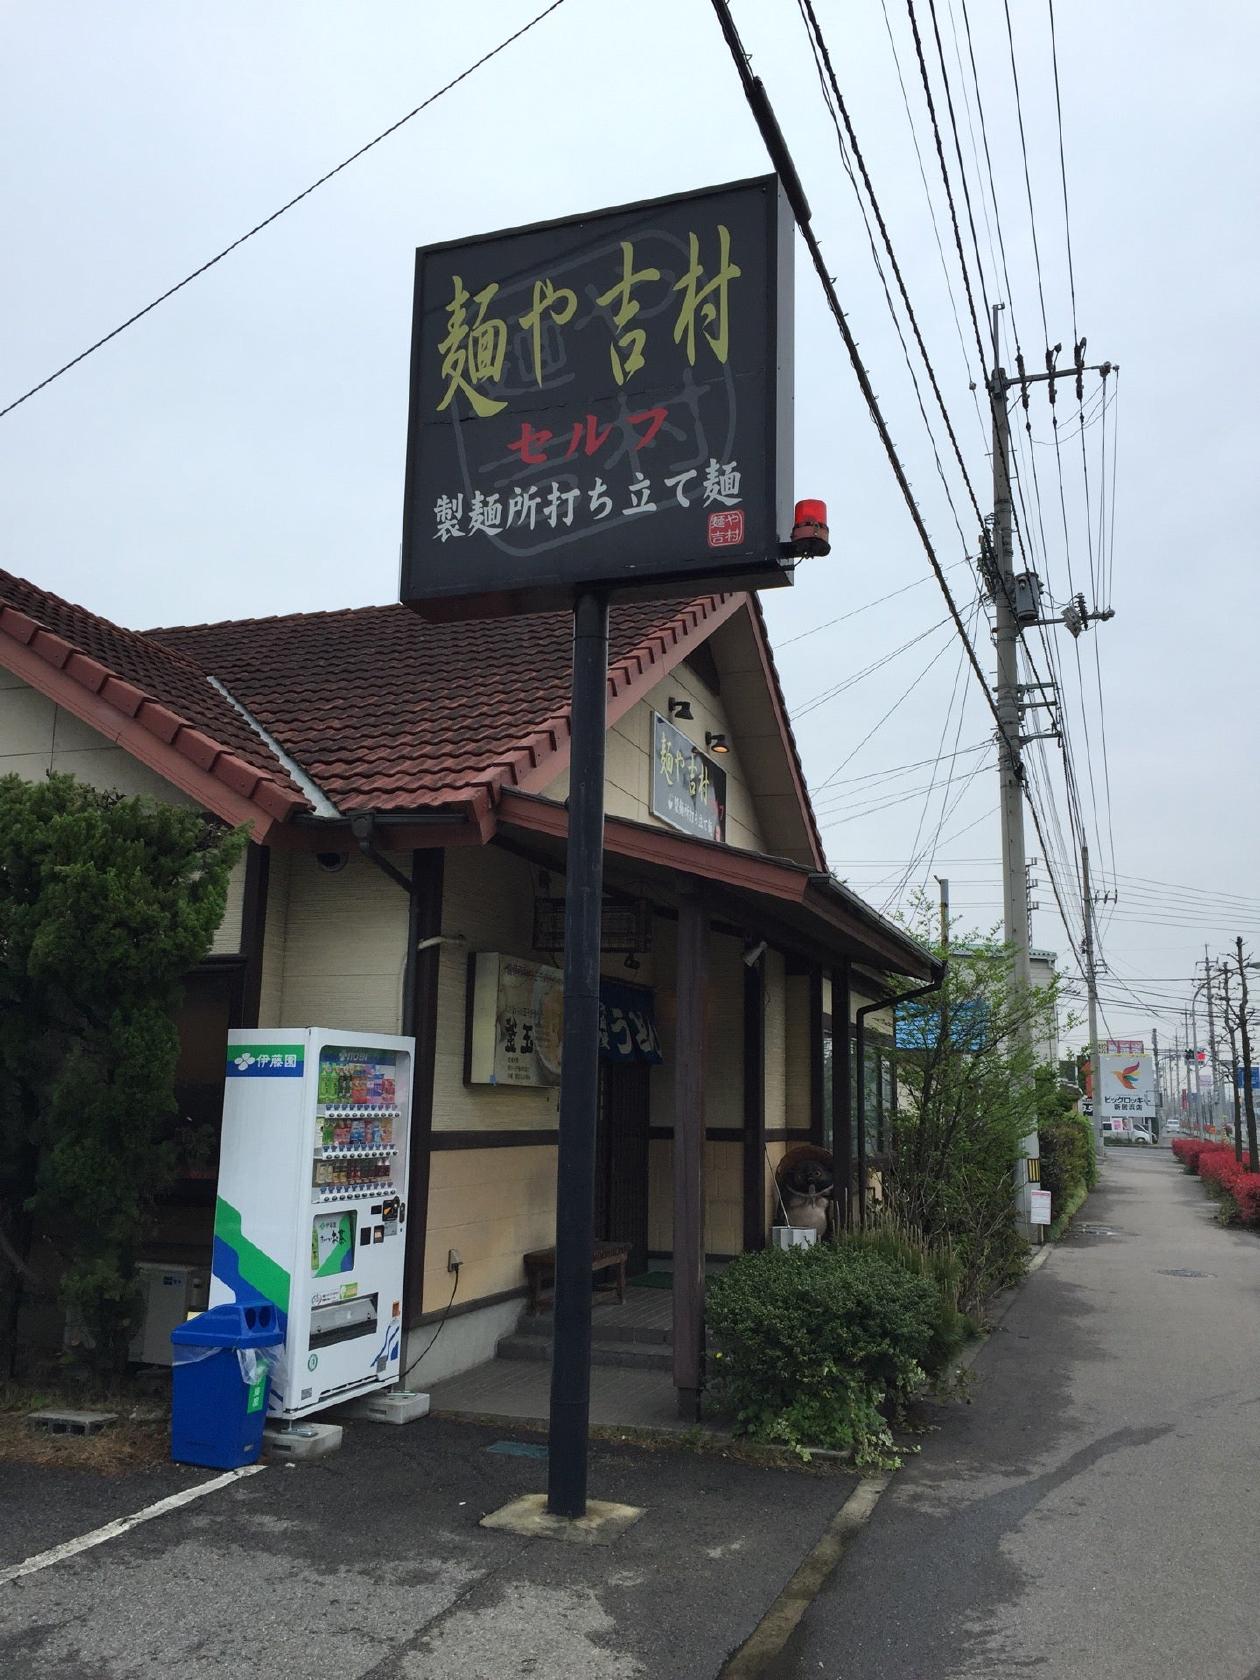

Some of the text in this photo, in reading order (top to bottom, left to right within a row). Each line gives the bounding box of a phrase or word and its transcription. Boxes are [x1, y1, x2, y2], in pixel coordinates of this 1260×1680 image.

[436, 224, 741, 418] 麺や吉村
[507, 407, 669, 465] セルフ
[432, 457, 744, 544] 製麺所打ち立て麺
[256, 1054, 297, 1069] 伊藤園
